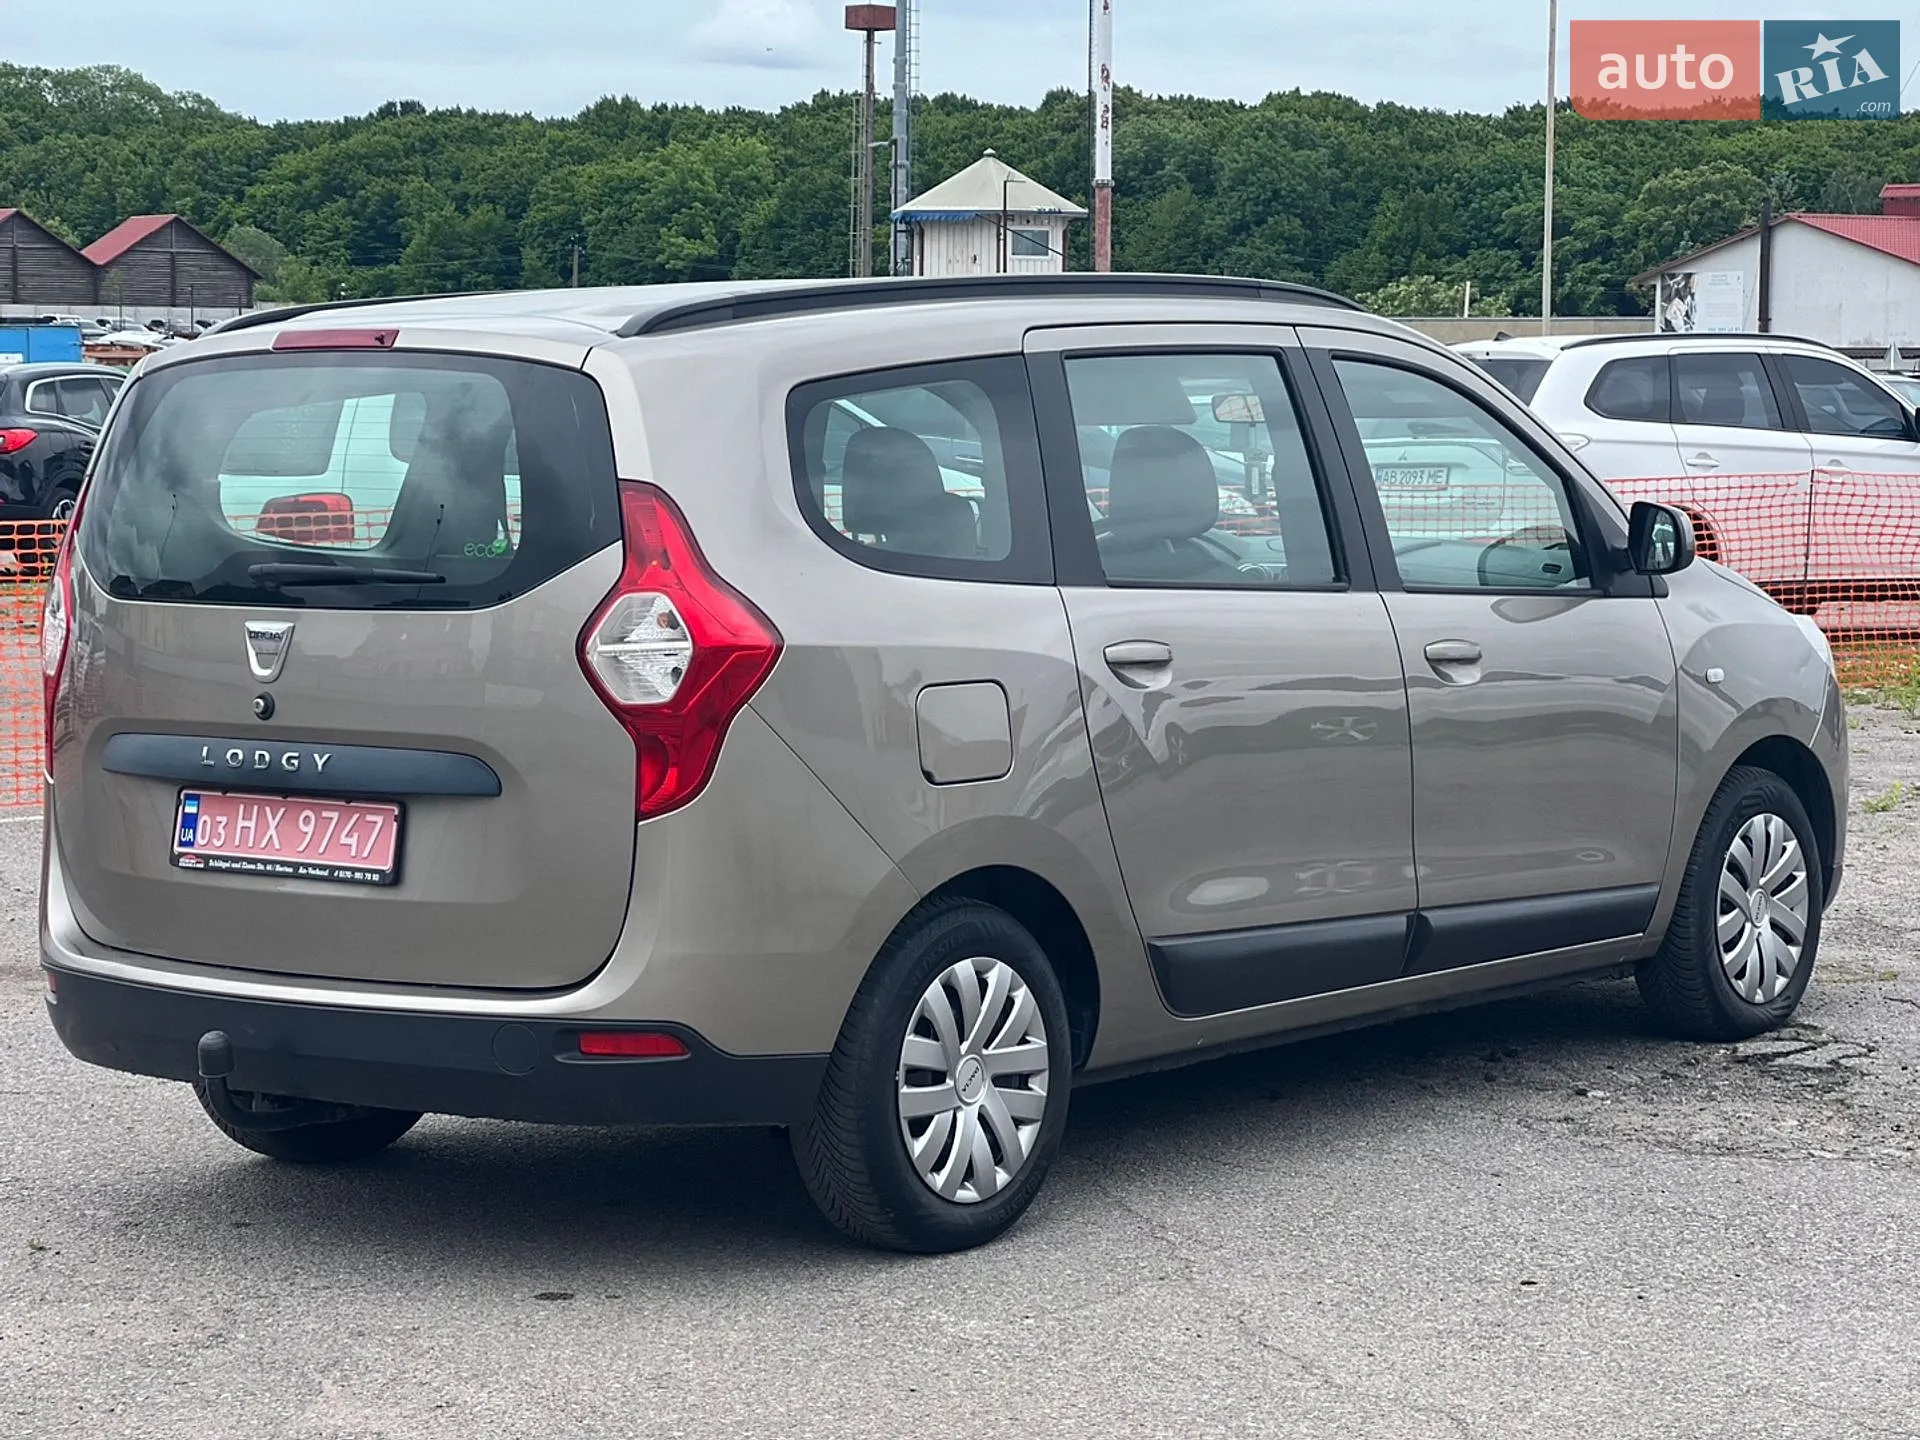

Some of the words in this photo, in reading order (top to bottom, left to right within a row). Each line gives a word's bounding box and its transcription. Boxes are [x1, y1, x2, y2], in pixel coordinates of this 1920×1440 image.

[463, 542, 497, 558] eco
[201, 746, 332, 773] LODGY
[180, 828, 194, 842] UA
[197, 814, 228, 848] 03
[233, 803, 287, 850] HX
[296, 809, 385, 860] 9747
